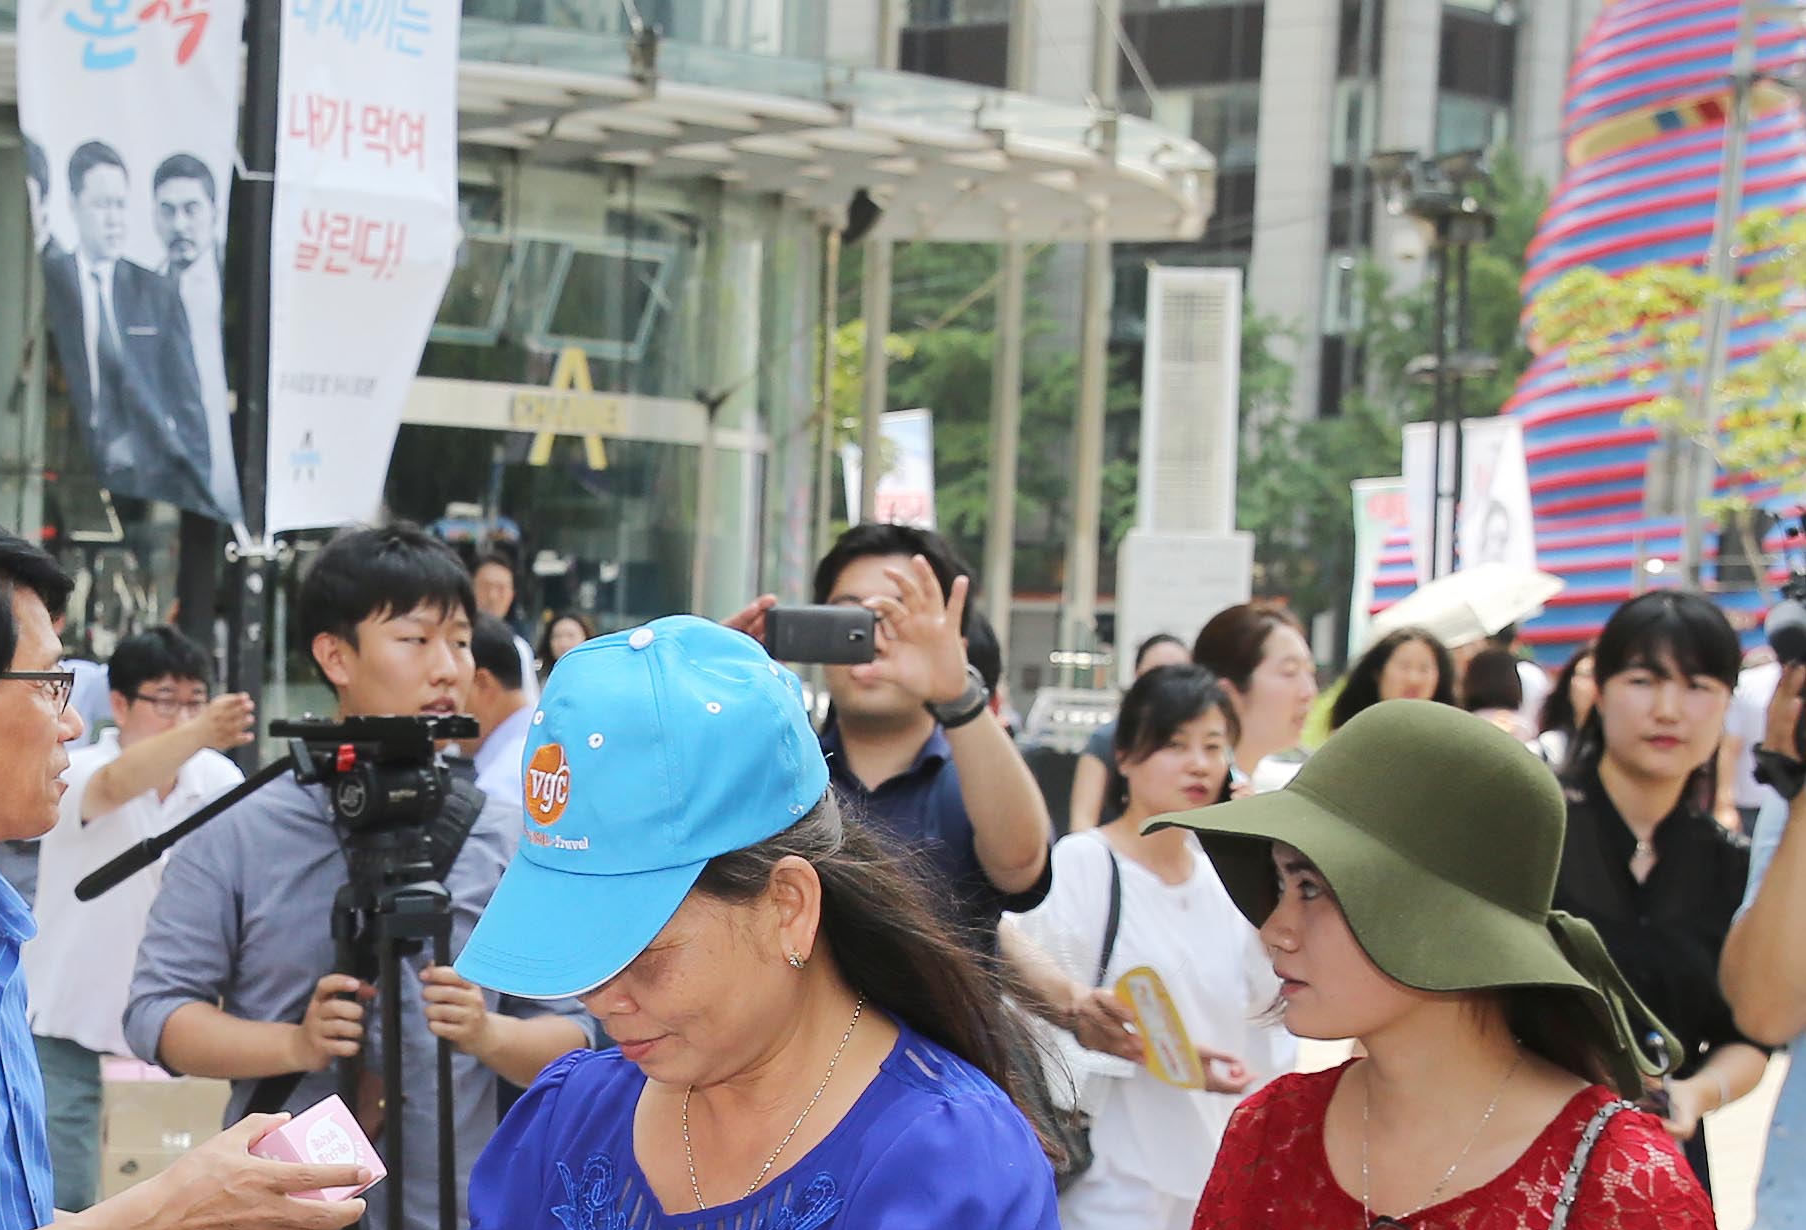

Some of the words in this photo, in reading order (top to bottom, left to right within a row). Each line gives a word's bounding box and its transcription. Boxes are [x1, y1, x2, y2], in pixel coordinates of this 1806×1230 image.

[289, 94, 353, 158] 내가
[362, 105, 427, 171] 먹여
[295, 208, 408, 281] 살린다!
